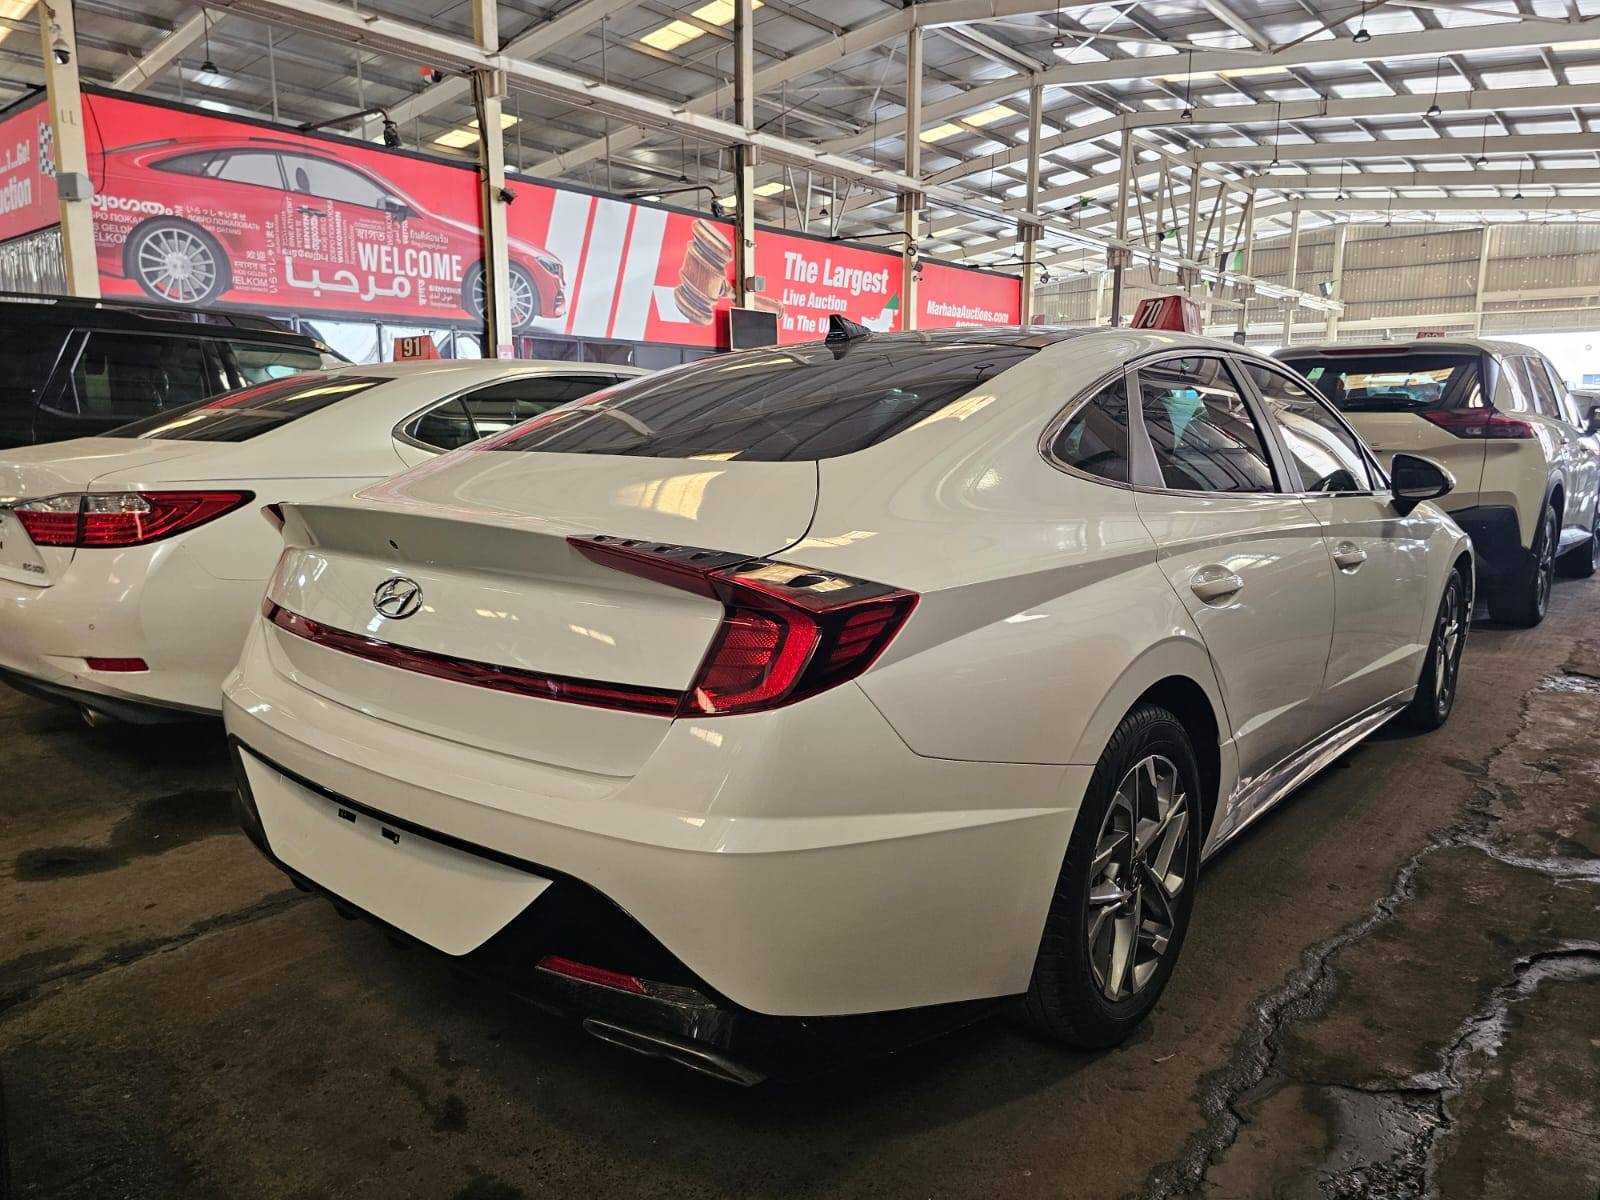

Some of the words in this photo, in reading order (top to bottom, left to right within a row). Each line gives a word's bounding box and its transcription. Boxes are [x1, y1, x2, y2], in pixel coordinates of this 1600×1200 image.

[357, 242, 463, 282] WELCOME
[784, 251, 818, 284] The
[823, 258, 889, 296] Largest
[285, 254, 411, 302] مرحبا
[783, 288, 806, 308] Live
[807, 292, 847, 312] Auction
[926, 300, 1009, 324] MarhabaAuctions.com
[783, 314, 794, 330] In
[797, 315, 816, 332] The
[1137, 300, 1164, 329] 70
[403, 338, 420, 357] 91
